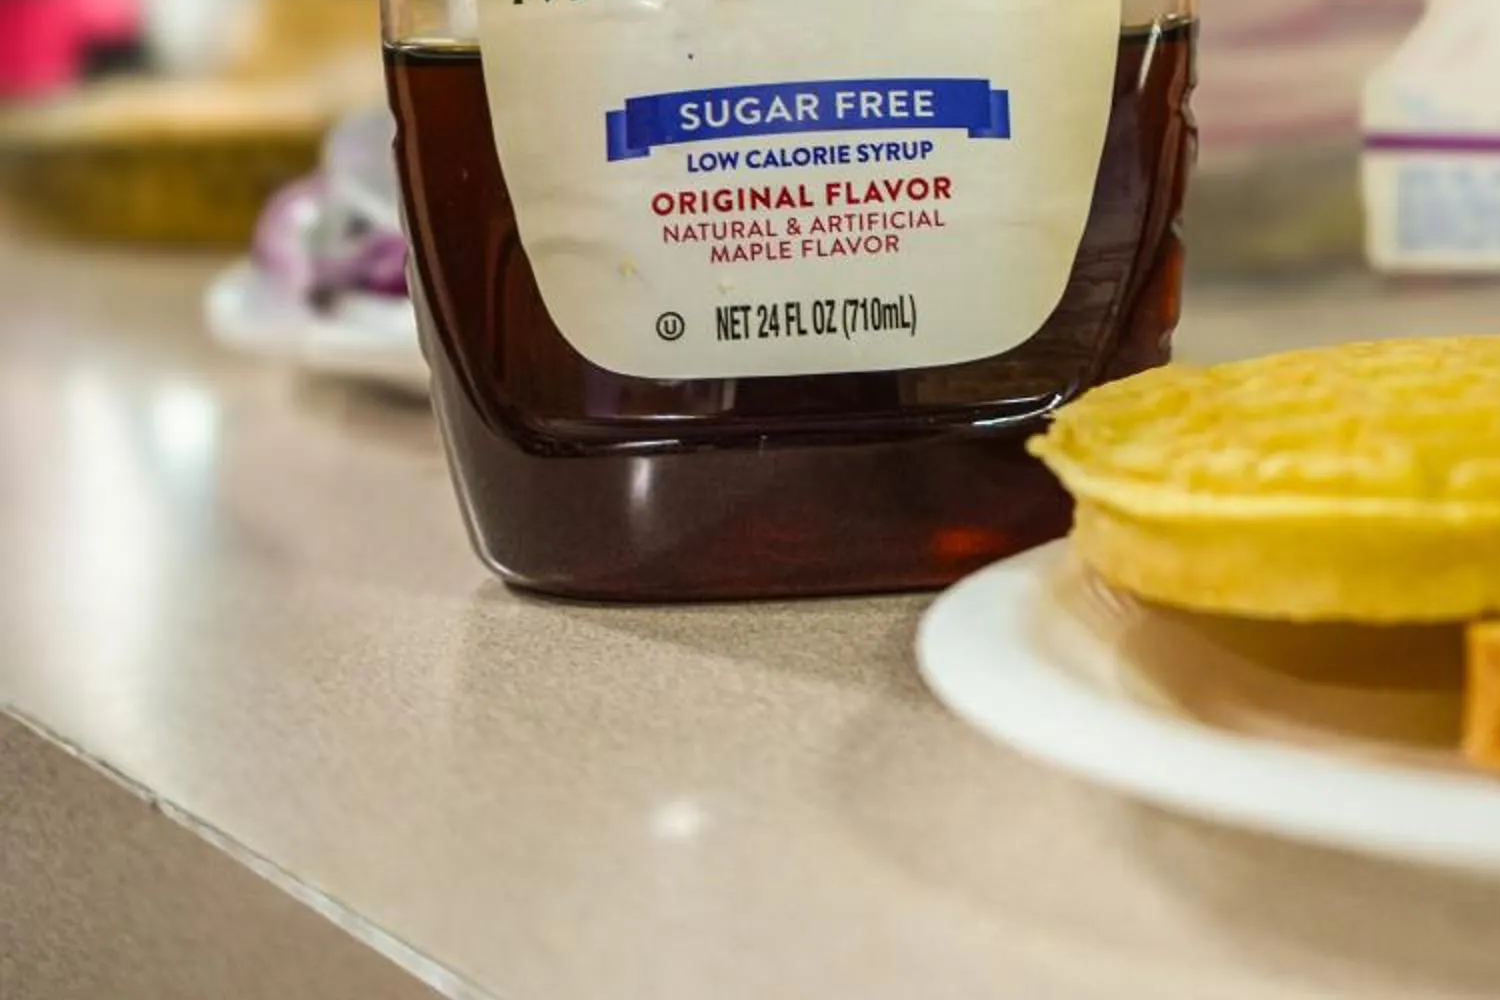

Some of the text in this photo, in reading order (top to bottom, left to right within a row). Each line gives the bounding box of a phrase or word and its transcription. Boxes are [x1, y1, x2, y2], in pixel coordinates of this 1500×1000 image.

[679, 89, 935, 132] SUGAR FREE
[686, 140, 935, 173] LOW CALORIE SYRUP
[651, 176, 952, 217] ORIGINAL FLAVOR
[663, 209, 946, 244] NATURAL & ARTIFICIAL
[710, 234, 900, 264] MAPLE FLAVOR
[715, 294, 917, 341] NET 24 FL OZ (710mL)
